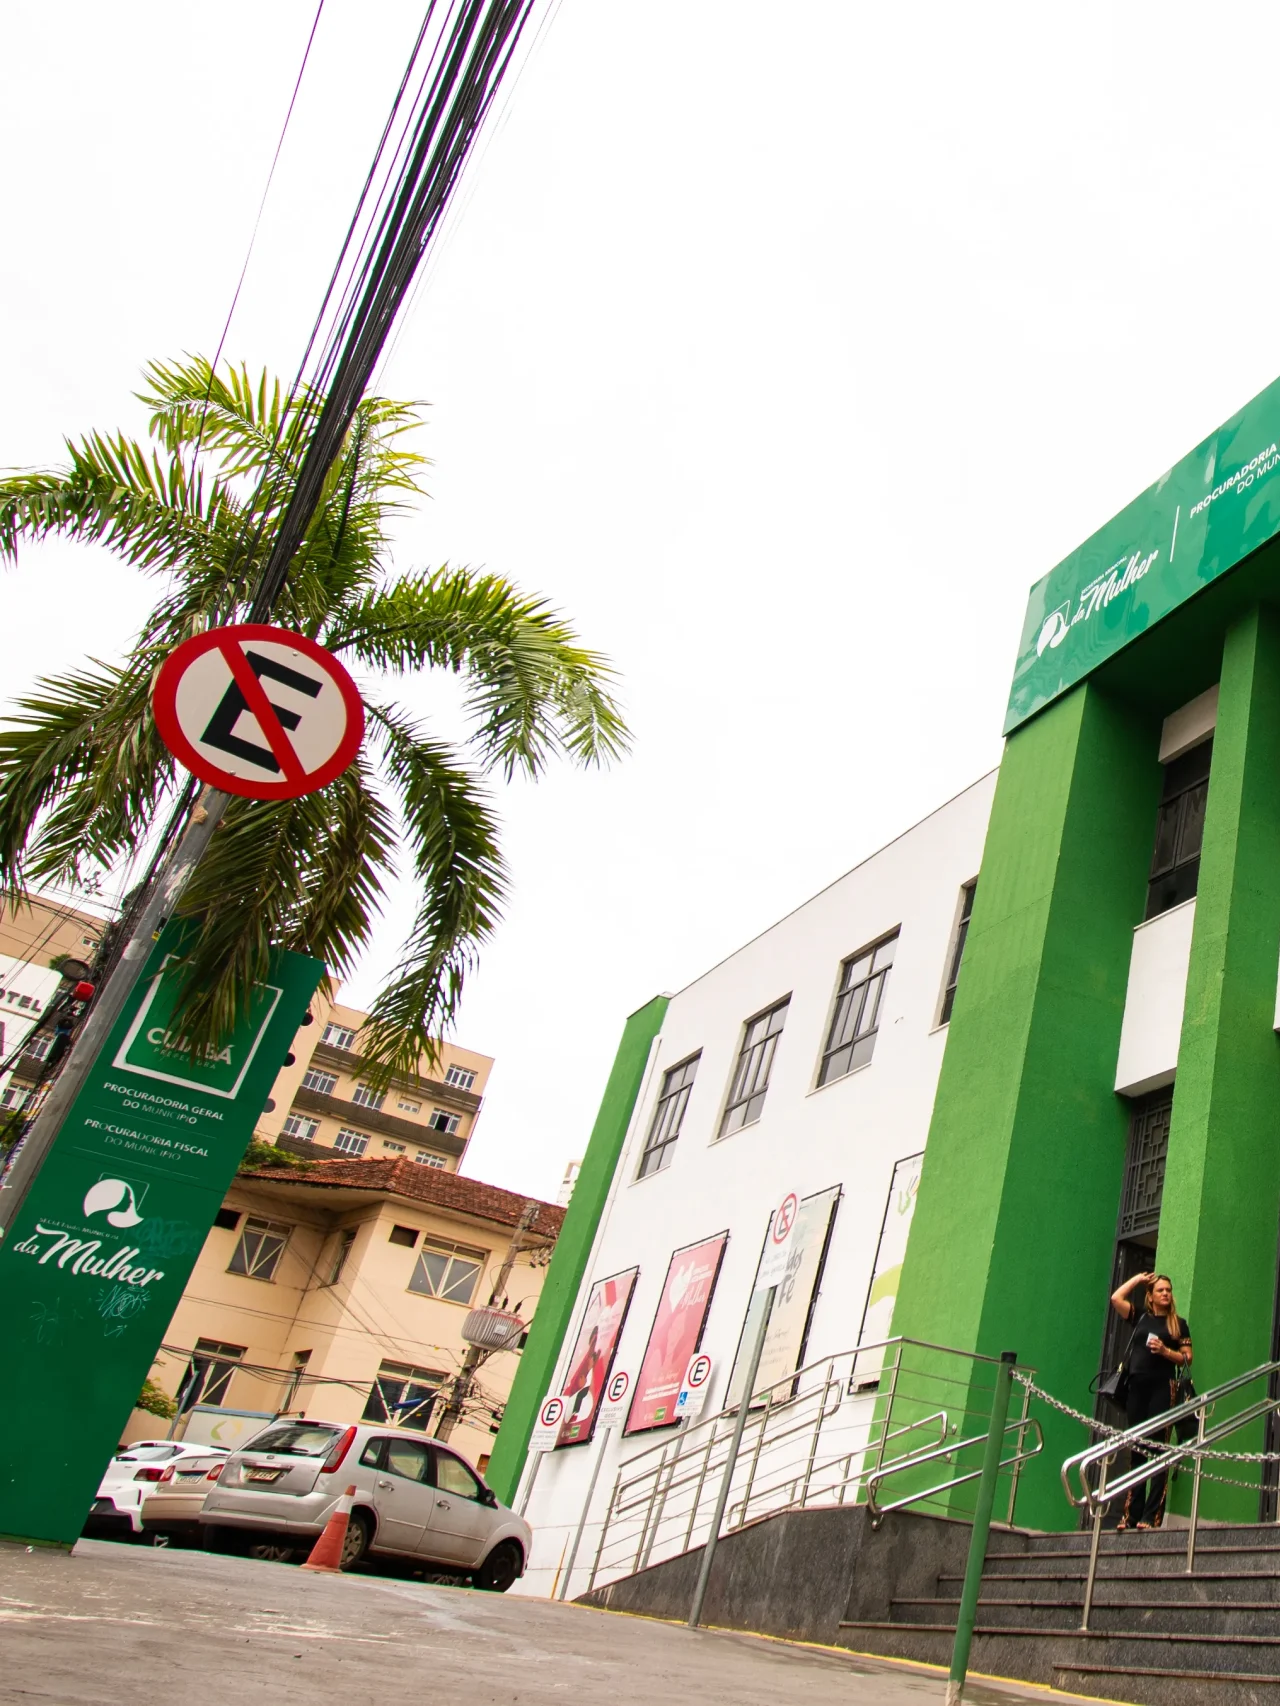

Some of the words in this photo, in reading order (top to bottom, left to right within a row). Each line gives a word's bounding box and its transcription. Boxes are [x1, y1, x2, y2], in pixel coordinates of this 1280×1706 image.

[1190, 443, 1277, 519] PROCURADORIA
[1237, 475, 1254, 494] DO
[1080, 549, 1159, 620] Mulher
[200, 650, 323, 774] E
[103, 1081, 189, 1112] PROCURADORIA
[191, 1106, 224, 1121] GERAL
[122, 1099, 140, 1109] DO
[84, 1118, 171, 1148] PROCURADORIA
[174, 1141, 209, 1157] FISCAL
[104, 1135, 123, 1146] DO
[13, 1234, 41, 1255] da
[36, 1223, 165, 1287] Mulher
[692, 1361, 706, 1382] E
[612, 1377, 624, 1397] E
[545, 1403, 558, 1421] E
